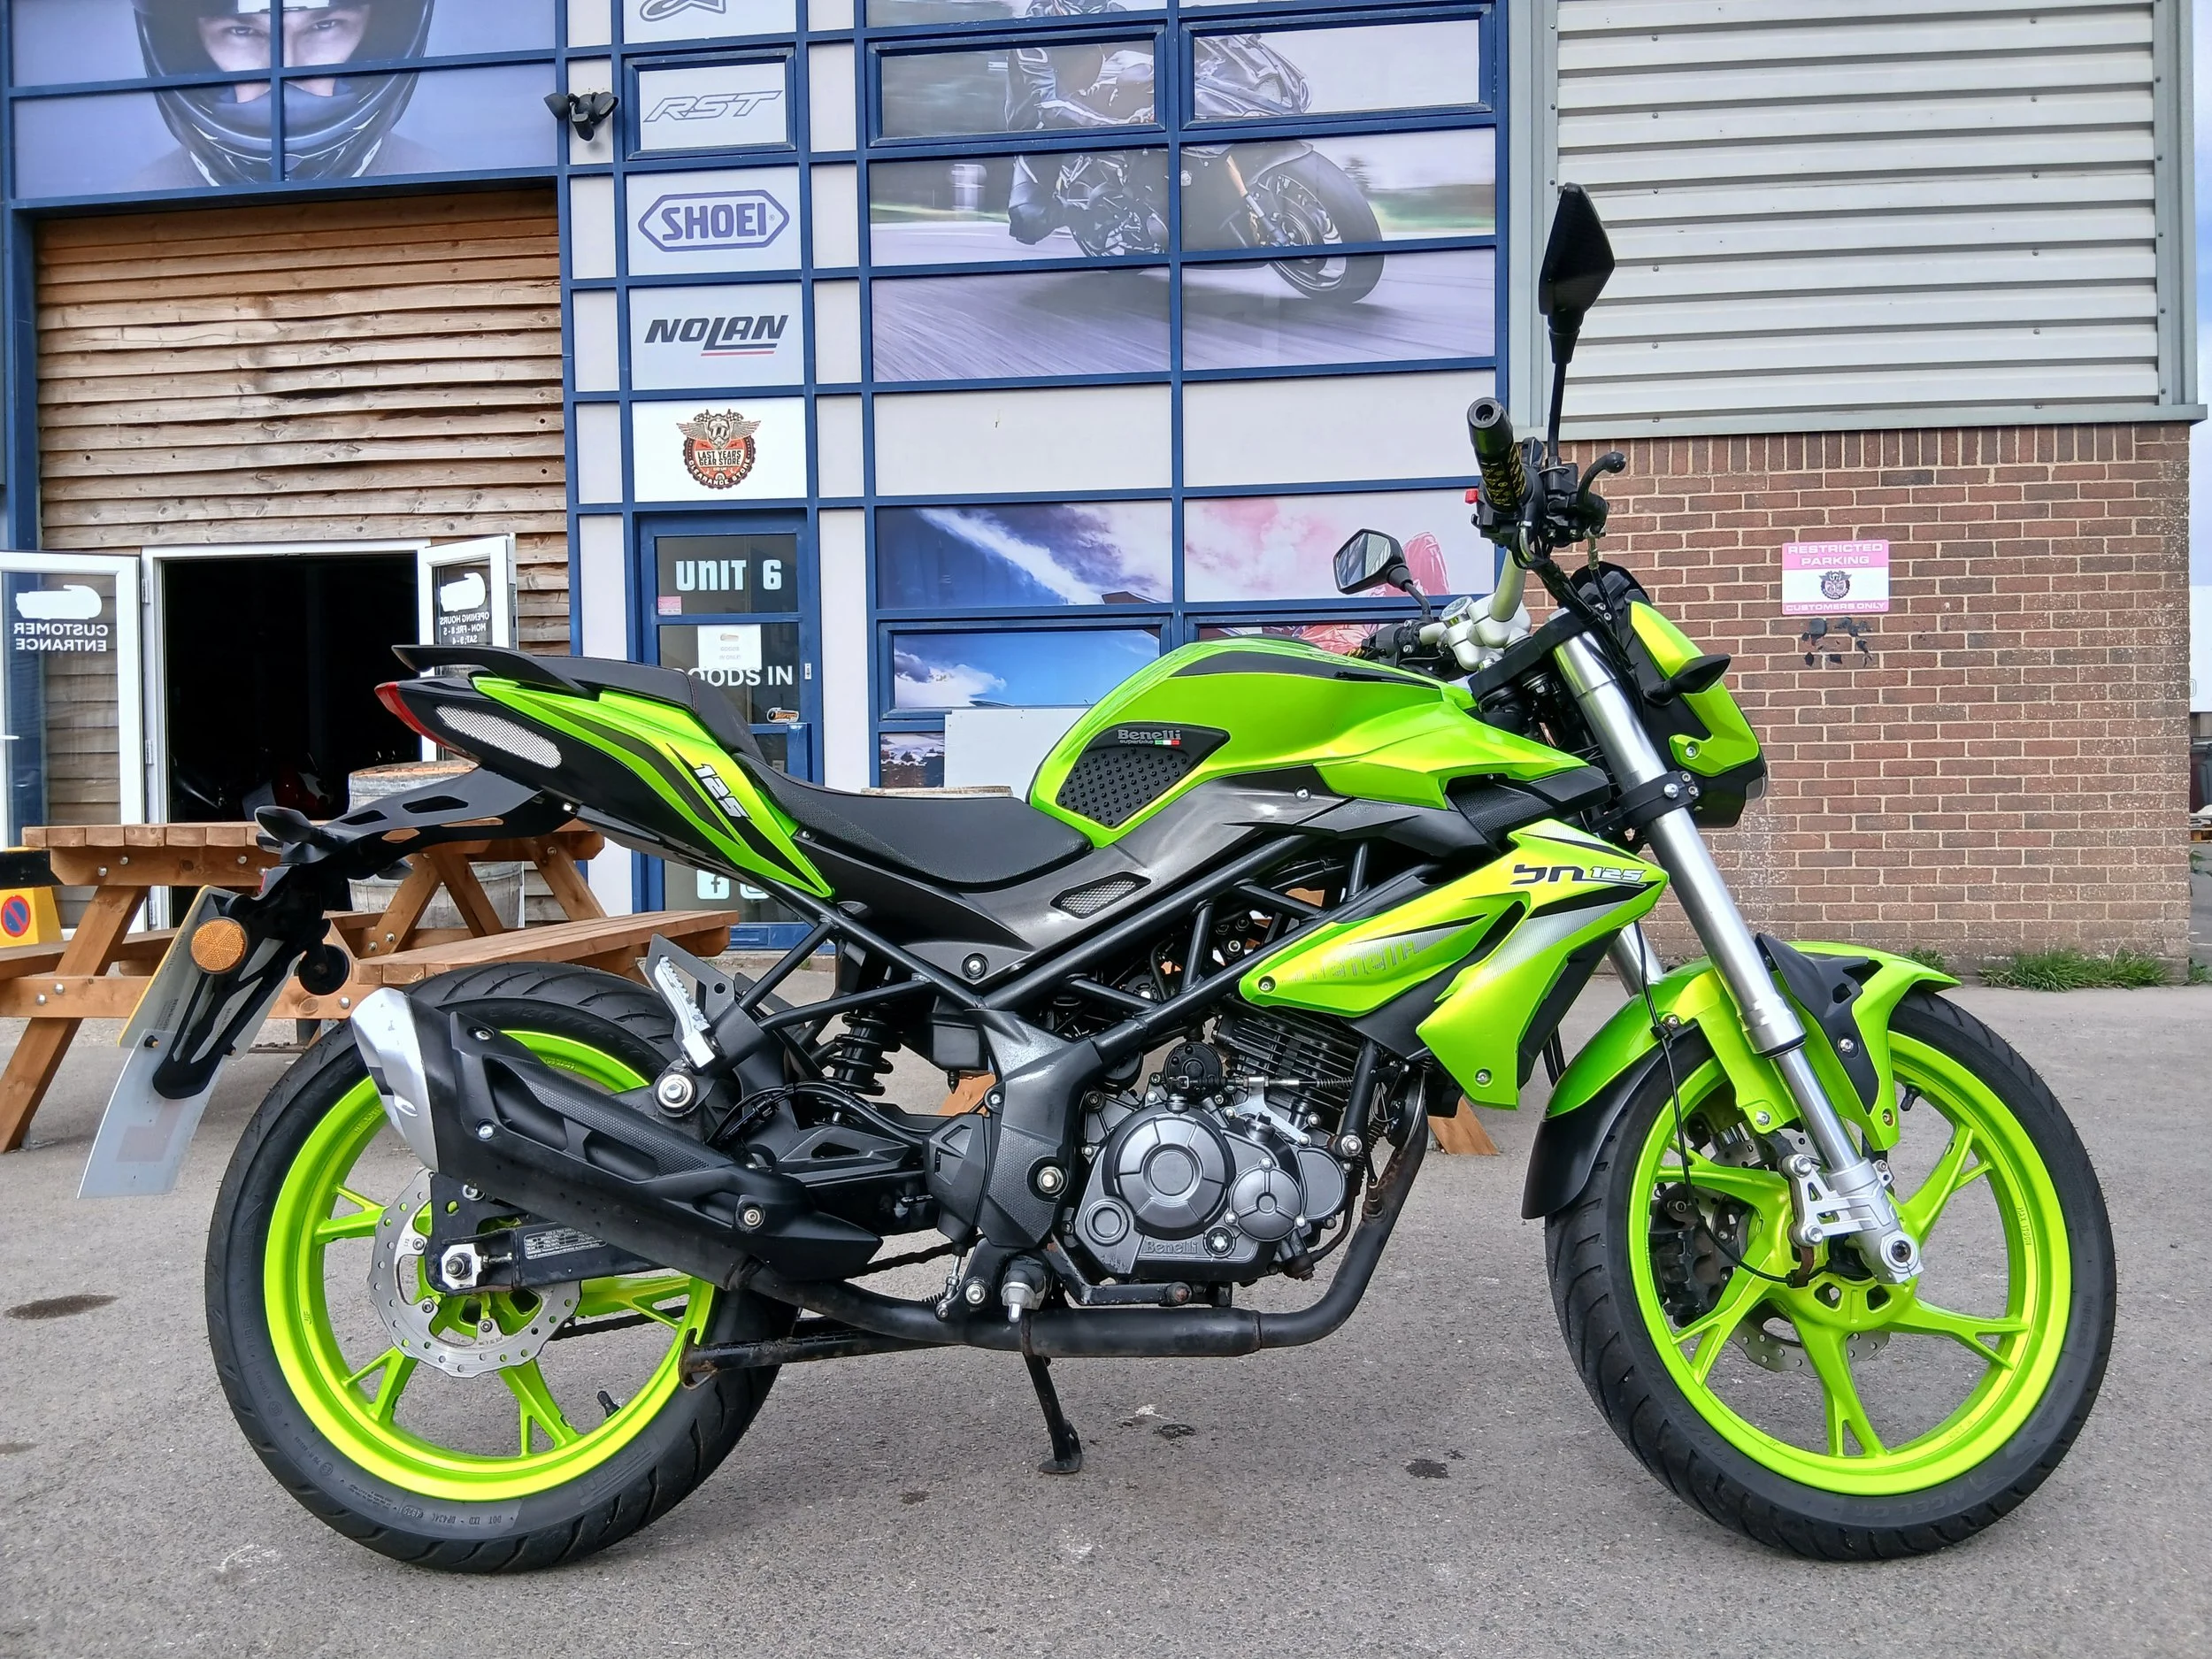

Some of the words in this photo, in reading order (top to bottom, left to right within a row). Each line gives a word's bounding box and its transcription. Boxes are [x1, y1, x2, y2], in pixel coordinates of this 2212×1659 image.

[642, 90, 783, 123] RST
[661, 203, 767, 241] SHOEI
[643, 315, 789, 351] NOLAN
[718, 449, 741, 458] YEARS
[1787, 543, 1884, 554] RESTRICTED
[1801, 556, 1870, 566] PARKING
[675, 559, 747, 591] UNIT
[763, 559, 782, 590] 6
[1786, 603, 1855, 611] CUSTOMERS
[1856, 602, 1886, 611] ONLY
[672, 667, 761, 687] OODS
[767, 665, 793, 686] IN
[1118, 729, 1181, 741] Benelli
[694, 763, 752, 820] 125
[1589, 865, 1647, 883] 125
[1143, 1240, 1199, 1255] Benelli
[488, 1515, 502, 1525] DOT
